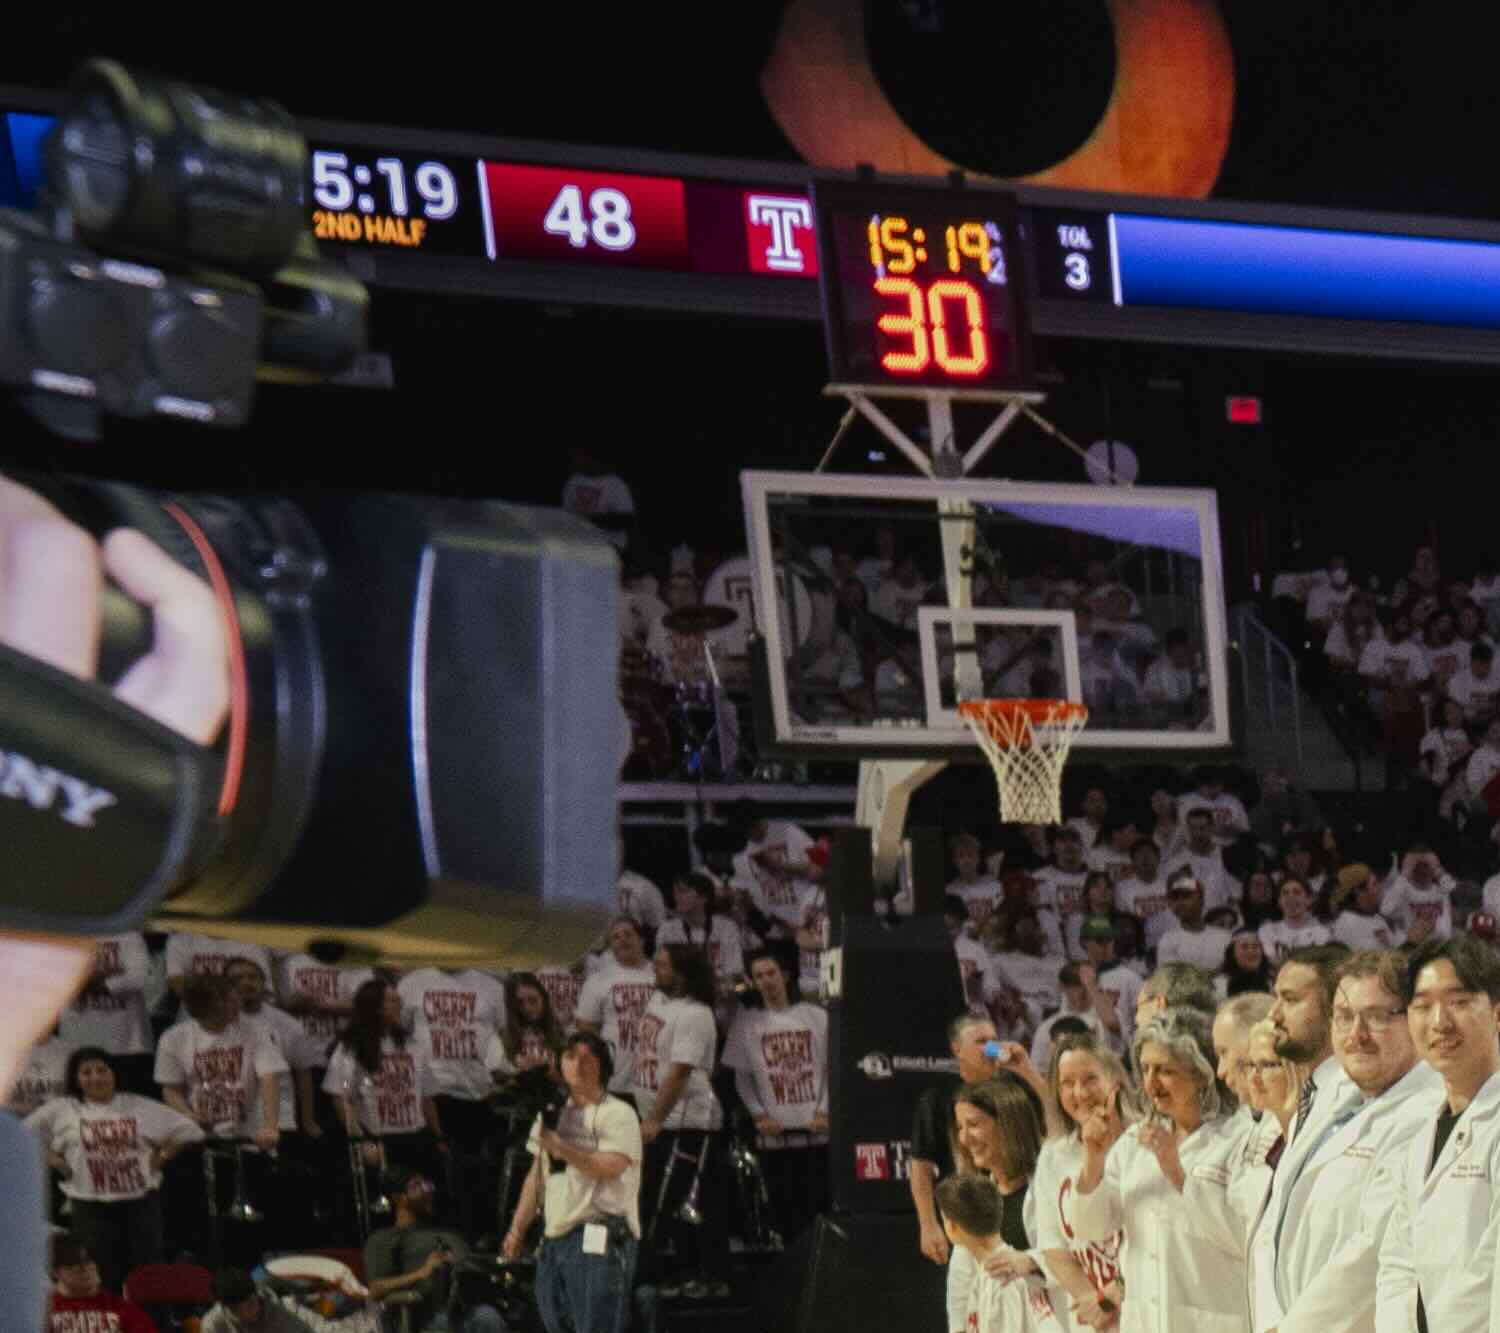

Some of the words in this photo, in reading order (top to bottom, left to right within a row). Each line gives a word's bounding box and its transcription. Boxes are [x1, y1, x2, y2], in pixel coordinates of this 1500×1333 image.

[312, 212, 361, 241] 2ND
[364, 214, 427, 246] HALF
[543, 185, 636, 251] 48
[1057, 224, 1093, 250] TOL
[867, 216, 991, 274] 15:19
[1063, 252, 1091, 290] 3
[873, 277, 987, 374] 30
